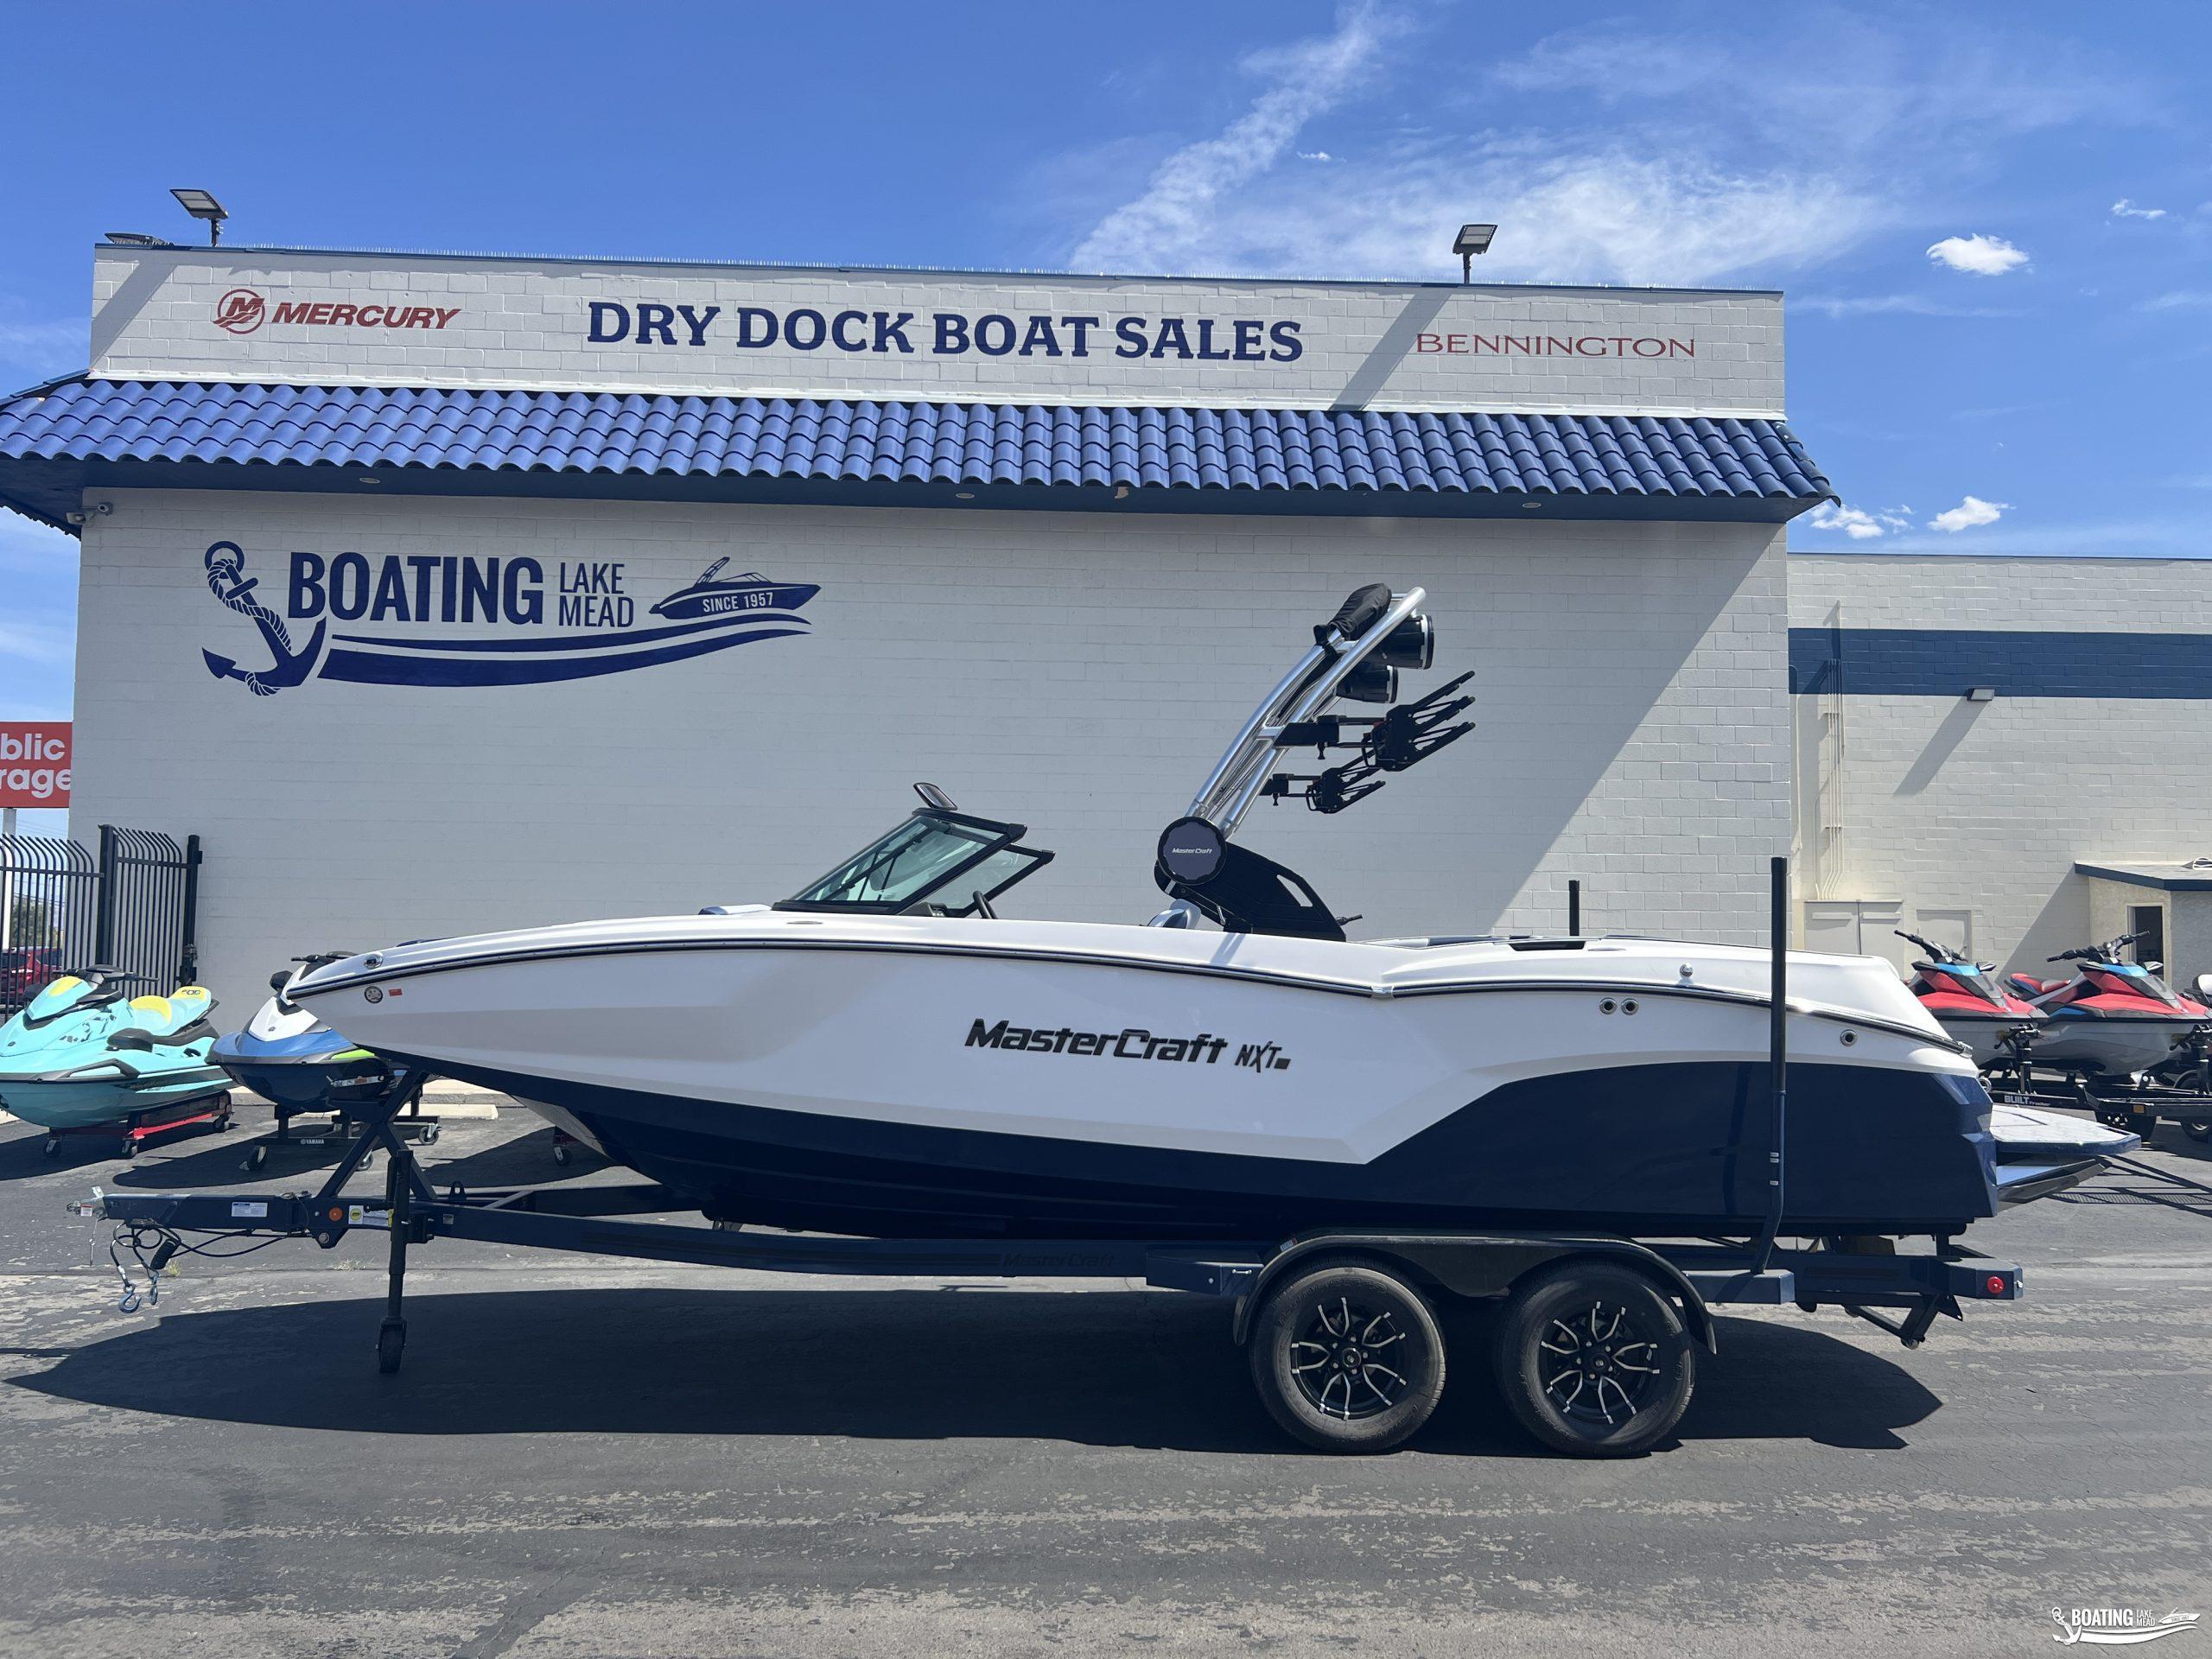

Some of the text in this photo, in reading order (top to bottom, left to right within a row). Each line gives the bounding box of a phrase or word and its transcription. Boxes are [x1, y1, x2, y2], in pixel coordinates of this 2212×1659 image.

[272, 302, 461, 329] MERCURY
[588, 302, 1303, 362] DRY DOCK BOAT SALES
[1416, 334, 1695, 358] BENNINGTON
[289, 552, 543, 625] BOATING
[560, 563, 625, 594] LAKE
[558, 594, 634, 627] MEAD
[702, 592, 773, 613] SINCE 1957
[0, 733, 66, 760] blic
[0, 768, 71, 799] rage
[964, 1018, 1229, 1065] MasterCraft
[2004, 1095, 2030, 1105] BUILT
